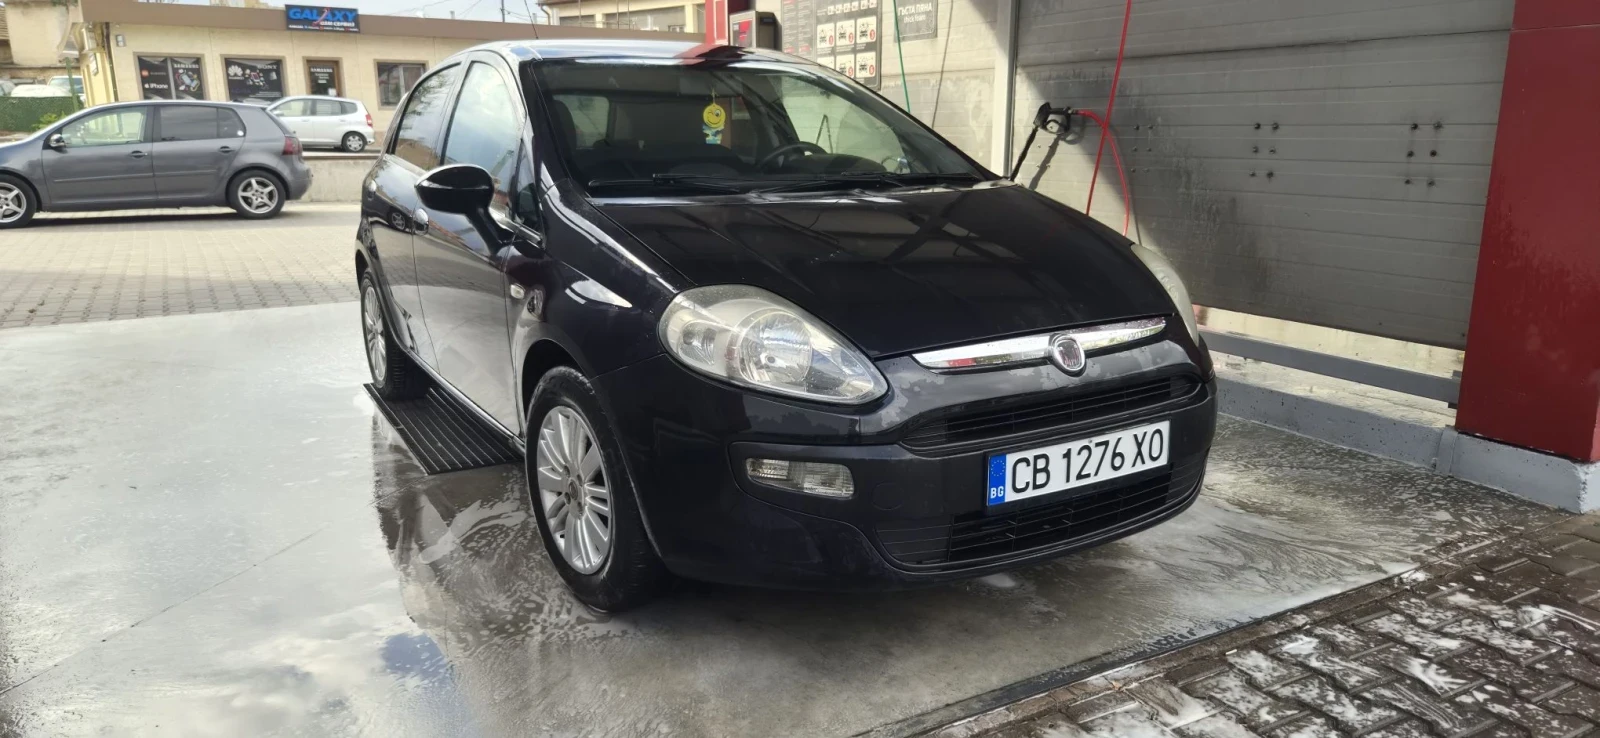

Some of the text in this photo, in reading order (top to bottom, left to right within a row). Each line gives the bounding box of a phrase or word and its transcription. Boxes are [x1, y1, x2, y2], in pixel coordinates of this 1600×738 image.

[288, 7, 356, 22] GALAXY
[898, 3, 932, 16] ГЪСТА ПЯНА
[903, 15, 914, 23] thick
[1011, 428, 1165, 494] CB 1276 XO
[990, 486, 1004, 499] BG
